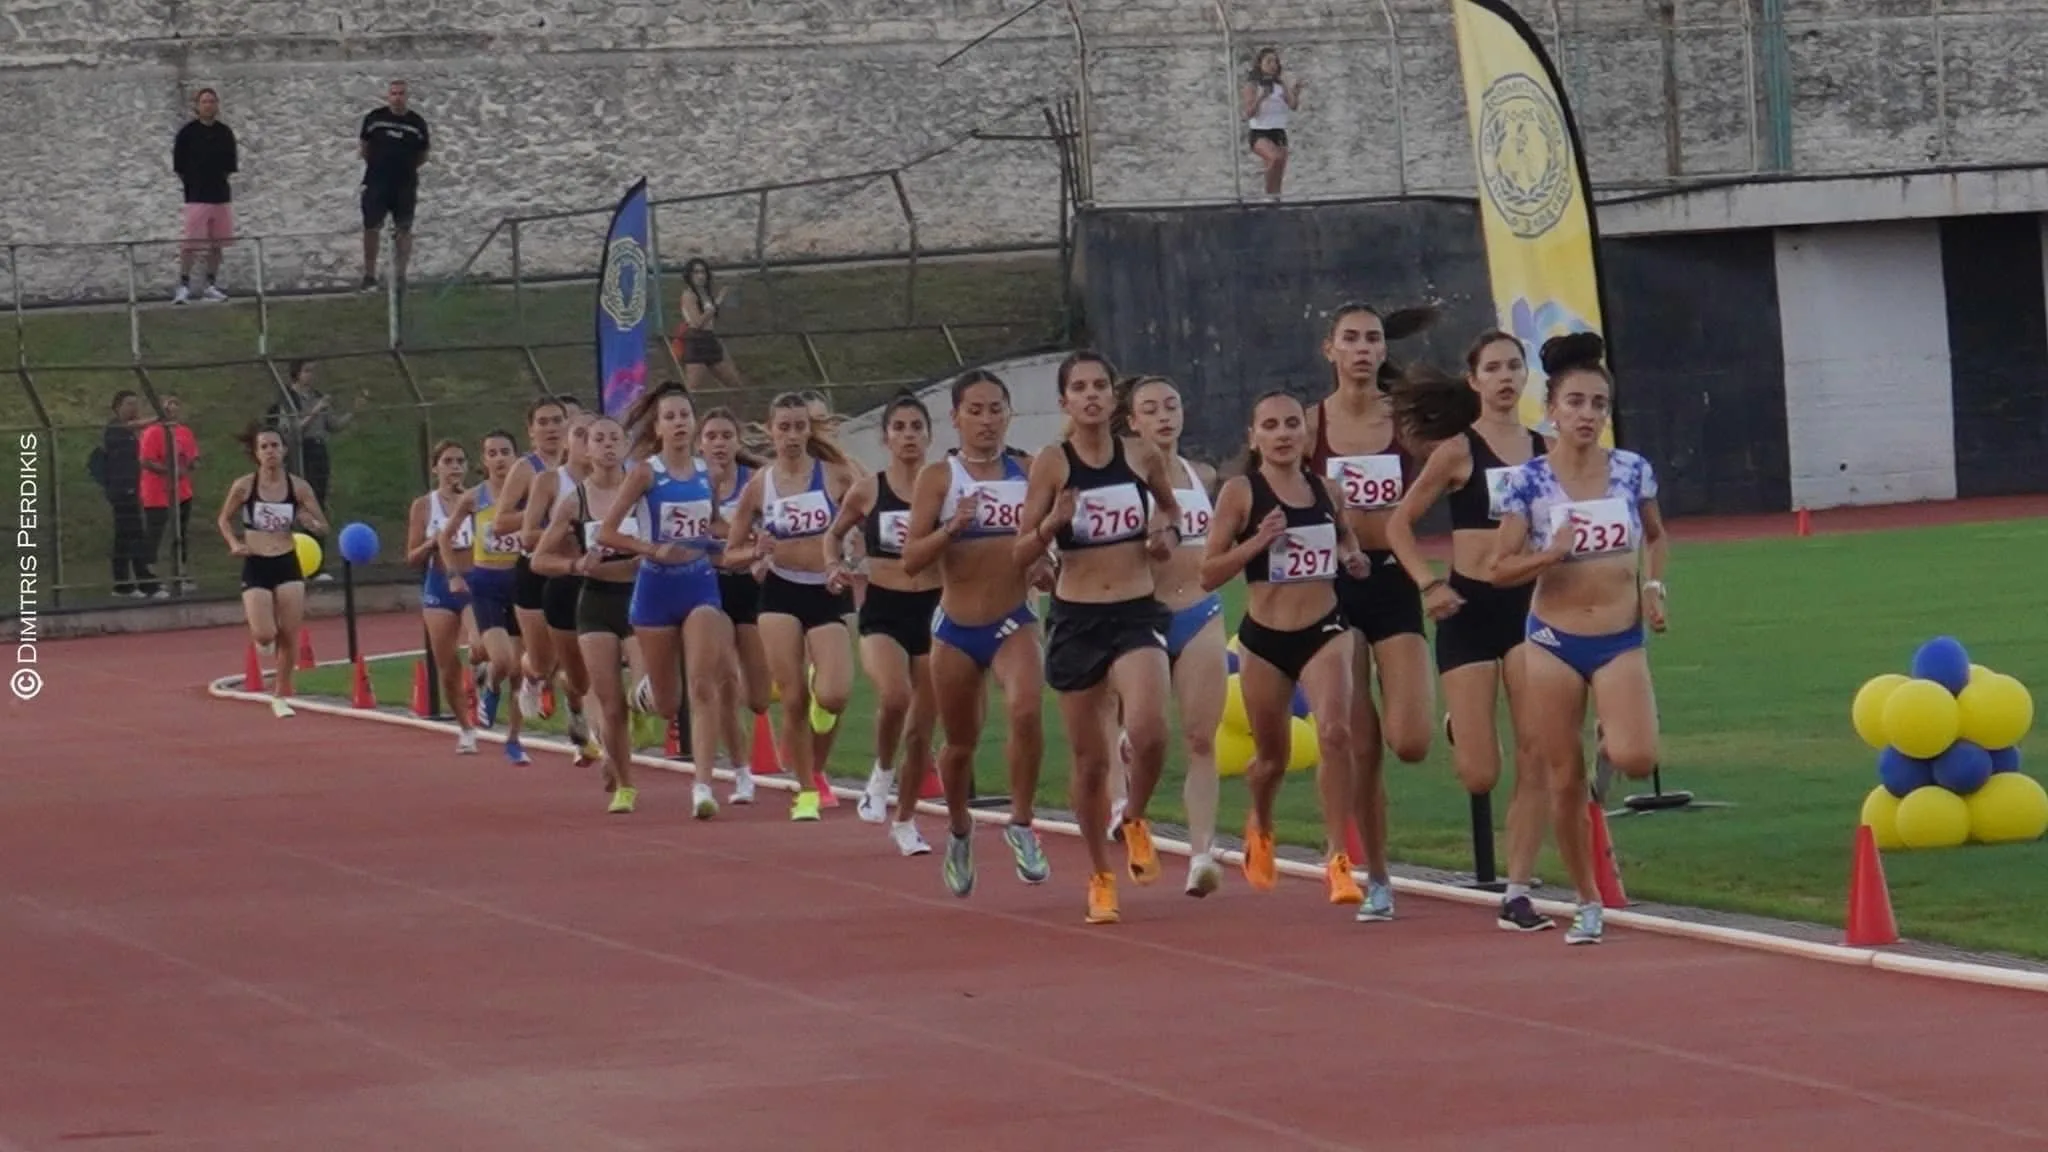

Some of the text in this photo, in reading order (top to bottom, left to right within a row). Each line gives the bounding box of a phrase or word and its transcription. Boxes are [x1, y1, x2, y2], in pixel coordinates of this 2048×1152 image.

[1345, 478, 1398, 504] 298
[672, 517, 709, 538] 218
[788, 508, 827, 533] 279
[1089, 505, 1139, 538] 276
[1574, 522, 1627, 553] 232
[1287, 548, 1333, 577] 297
